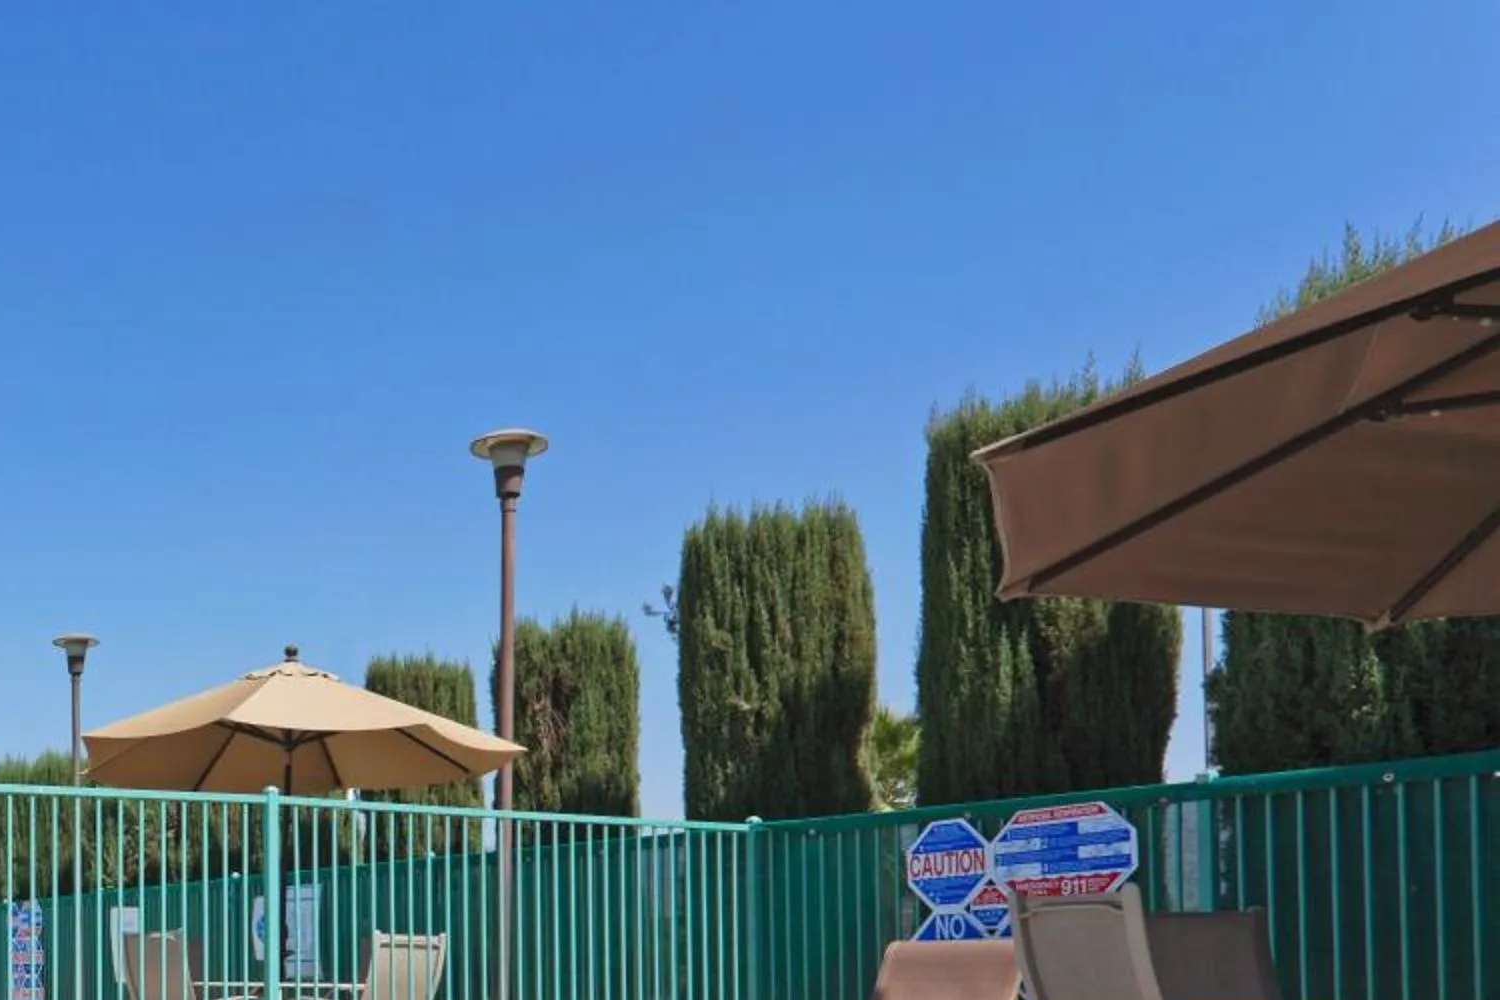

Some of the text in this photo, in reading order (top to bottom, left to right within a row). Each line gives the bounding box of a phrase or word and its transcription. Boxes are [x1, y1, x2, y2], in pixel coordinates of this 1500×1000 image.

[910, 849, 985, 877] CAUTION
[1061, 878, 1087, 896] 911
[935, 914, 965, 938] NO
